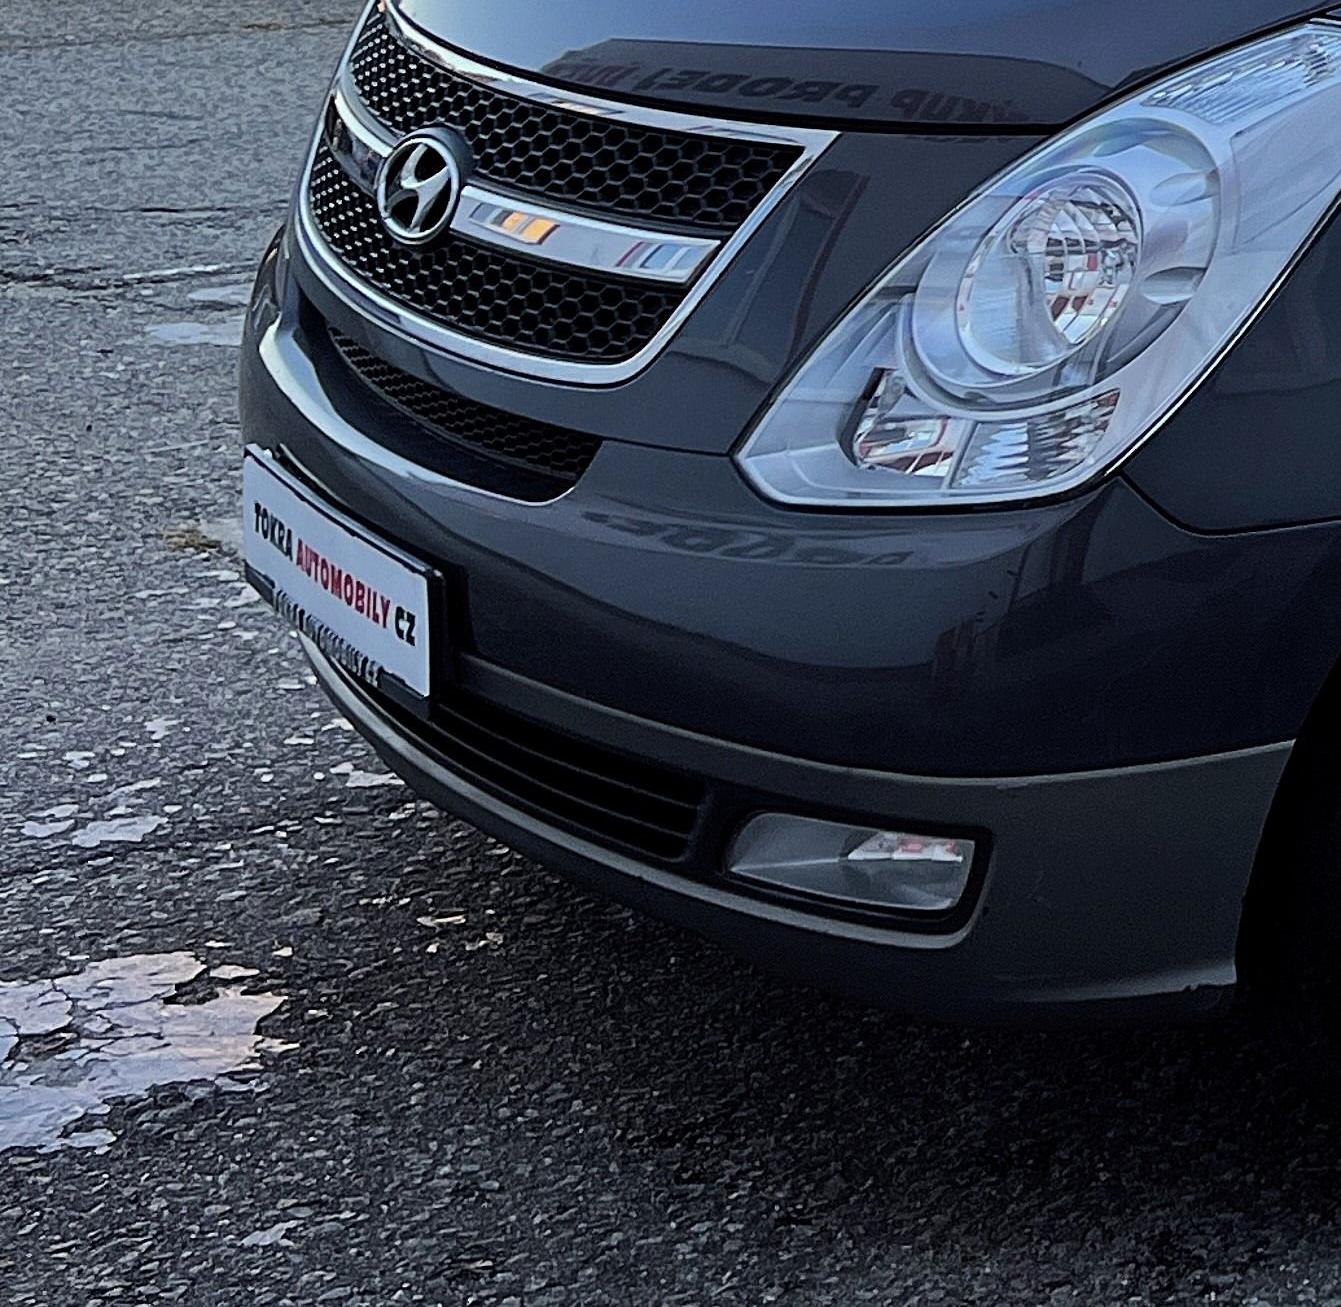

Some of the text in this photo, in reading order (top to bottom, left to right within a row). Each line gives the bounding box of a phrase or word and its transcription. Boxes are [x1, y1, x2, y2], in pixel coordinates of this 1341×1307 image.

[254, 501, 294, 562] TOKRA
[296, 539, 391, 629] AUTOMOBILY
[394, 605, 417, 647] CZ
